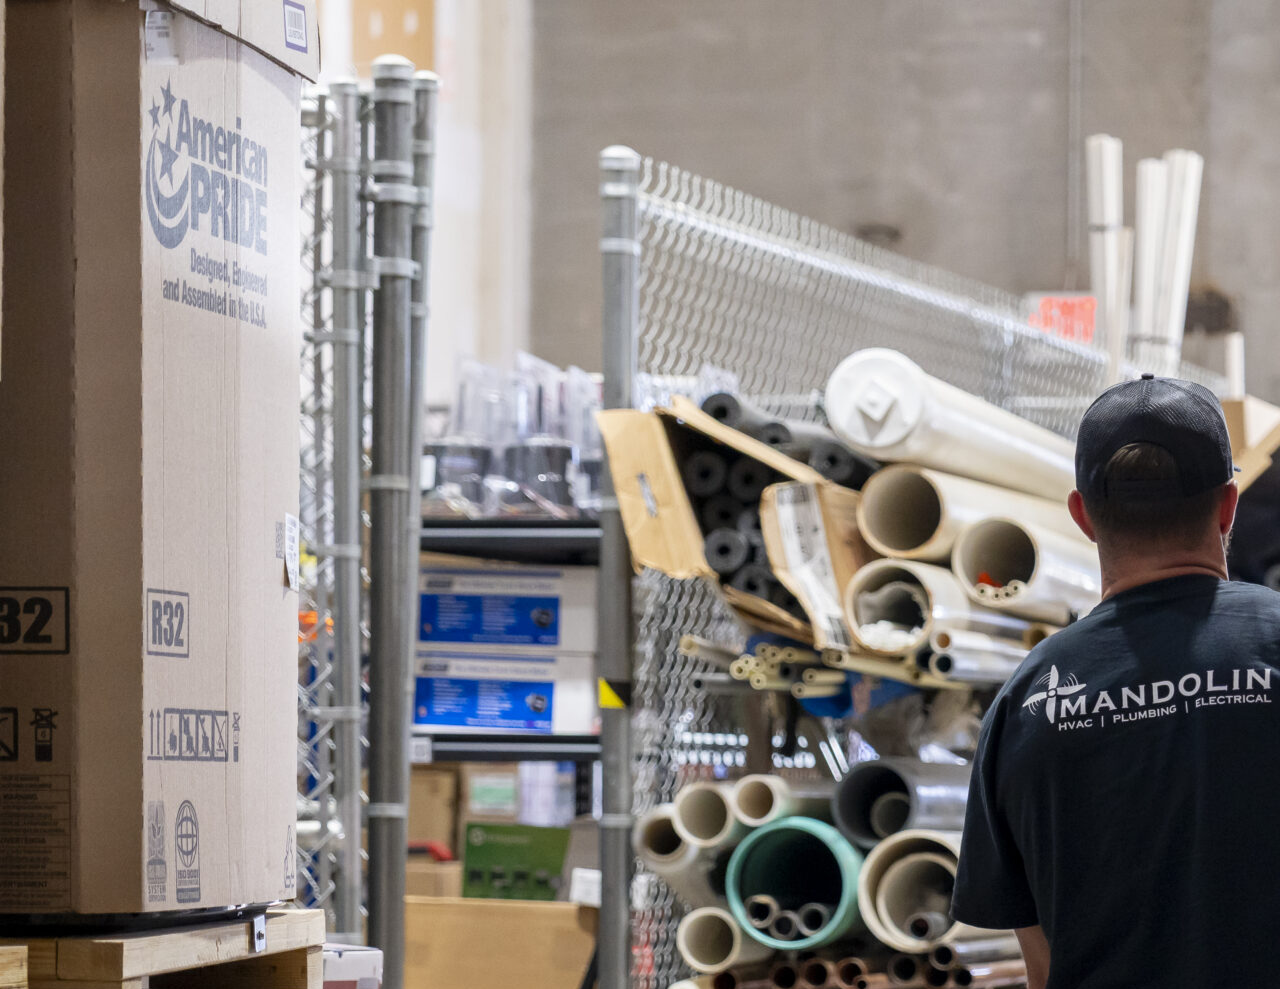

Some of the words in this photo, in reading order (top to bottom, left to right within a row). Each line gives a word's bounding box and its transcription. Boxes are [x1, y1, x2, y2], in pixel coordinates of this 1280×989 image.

[175, 99, 268, 187] American
[191, 162, 268, 256] PRIDE
[190, 247, 231, 288] Designed,
[162, 278, 180, 300] and
[181, 279, 227, 317] Assembled
[228, 293, 237, 318] in
[238, 295, 249, 322] the
[151, 599, 185, 648] R32
[1058, 719, 1093, 732] HVAC
[1112, 704, 1177, 724] PLUMBING
[1195, 693, 1272, 708] ELECTRICAL
[1060, 668, 1272, 718] MANDOLIN
